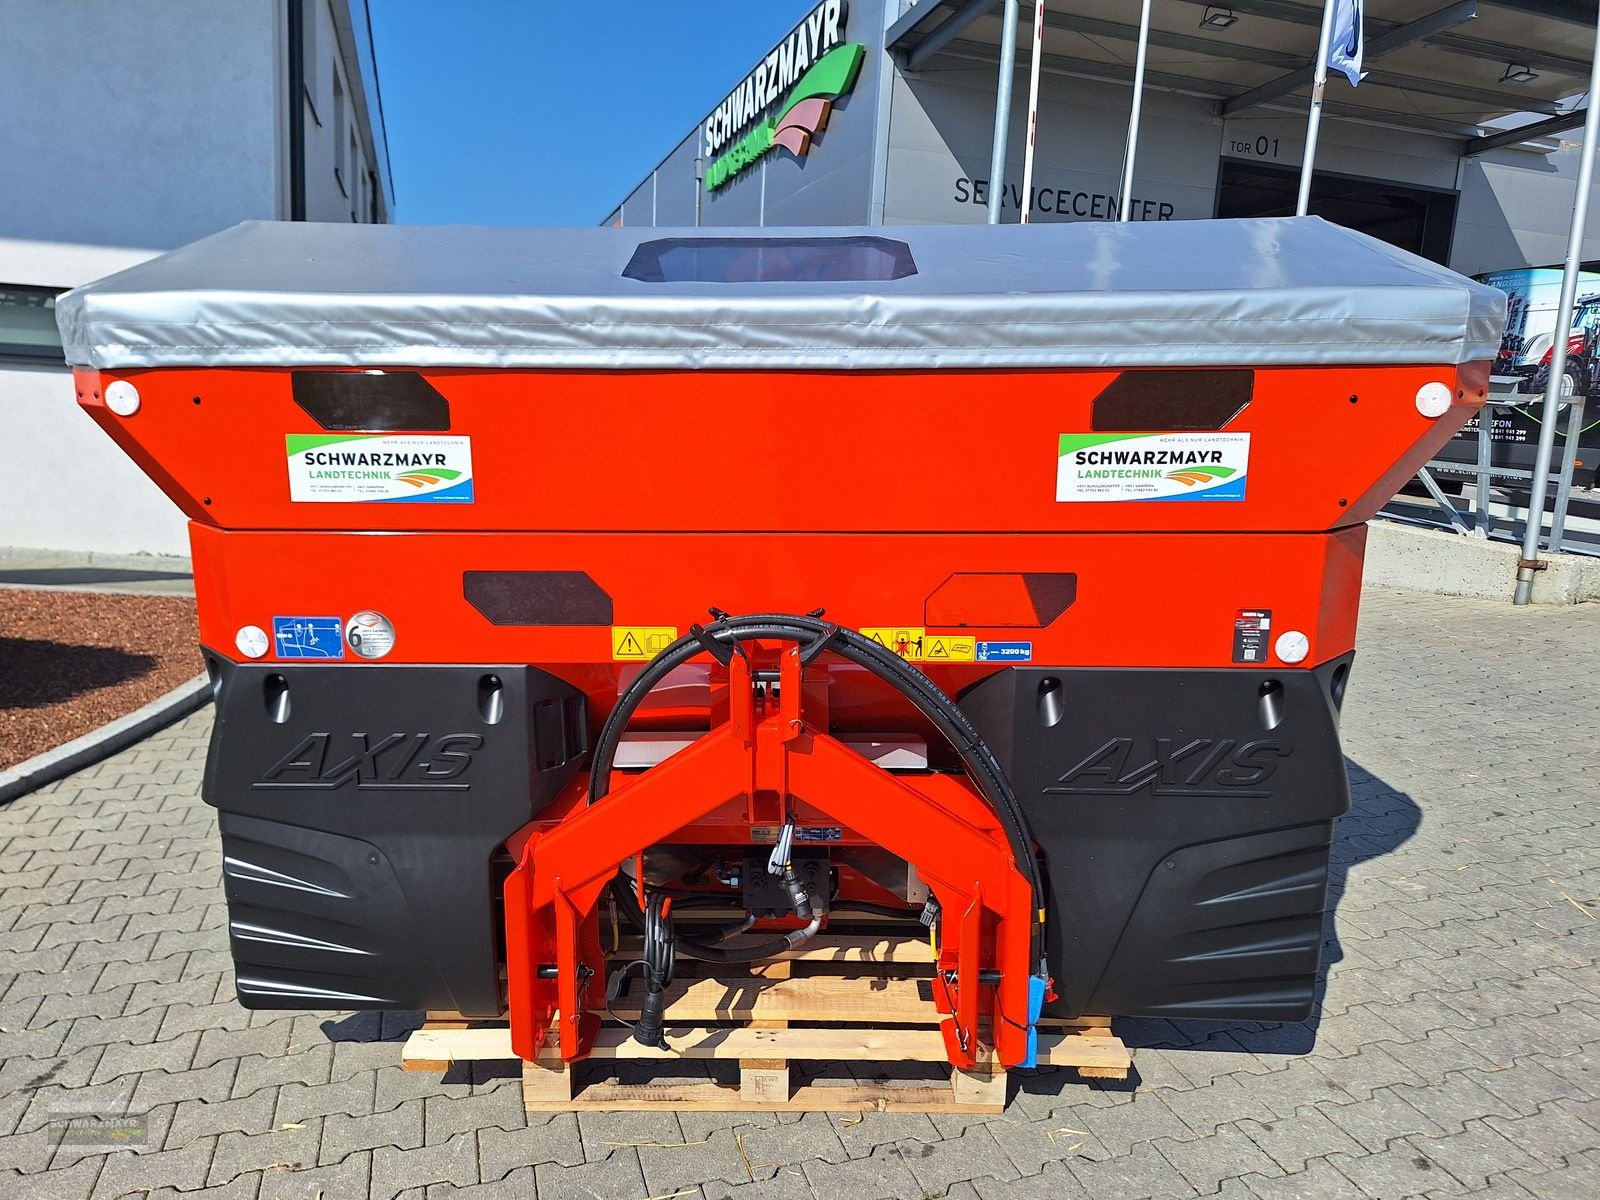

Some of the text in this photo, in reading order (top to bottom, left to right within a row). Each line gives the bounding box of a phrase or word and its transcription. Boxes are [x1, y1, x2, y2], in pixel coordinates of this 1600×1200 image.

[705, 0, 846, 157] SCHWARZMAYR
[1231, 136, 1279, 157] TOR 01
[305, 452, 446, 466] SCHWARZMAYR
[1075, 451, 1223, 465] SCHWARZMAYR
[309, 470, 391, 480] LANDTECHNIK
[1077, 469, 1162, 479] LANDTECHNIK
[348, 625, 362, 647] 6
[1020, 648, 1030, 656] kg
[264, 732, 485, 780] AXIS
[1058, 737, 1294, 786] AXIS
